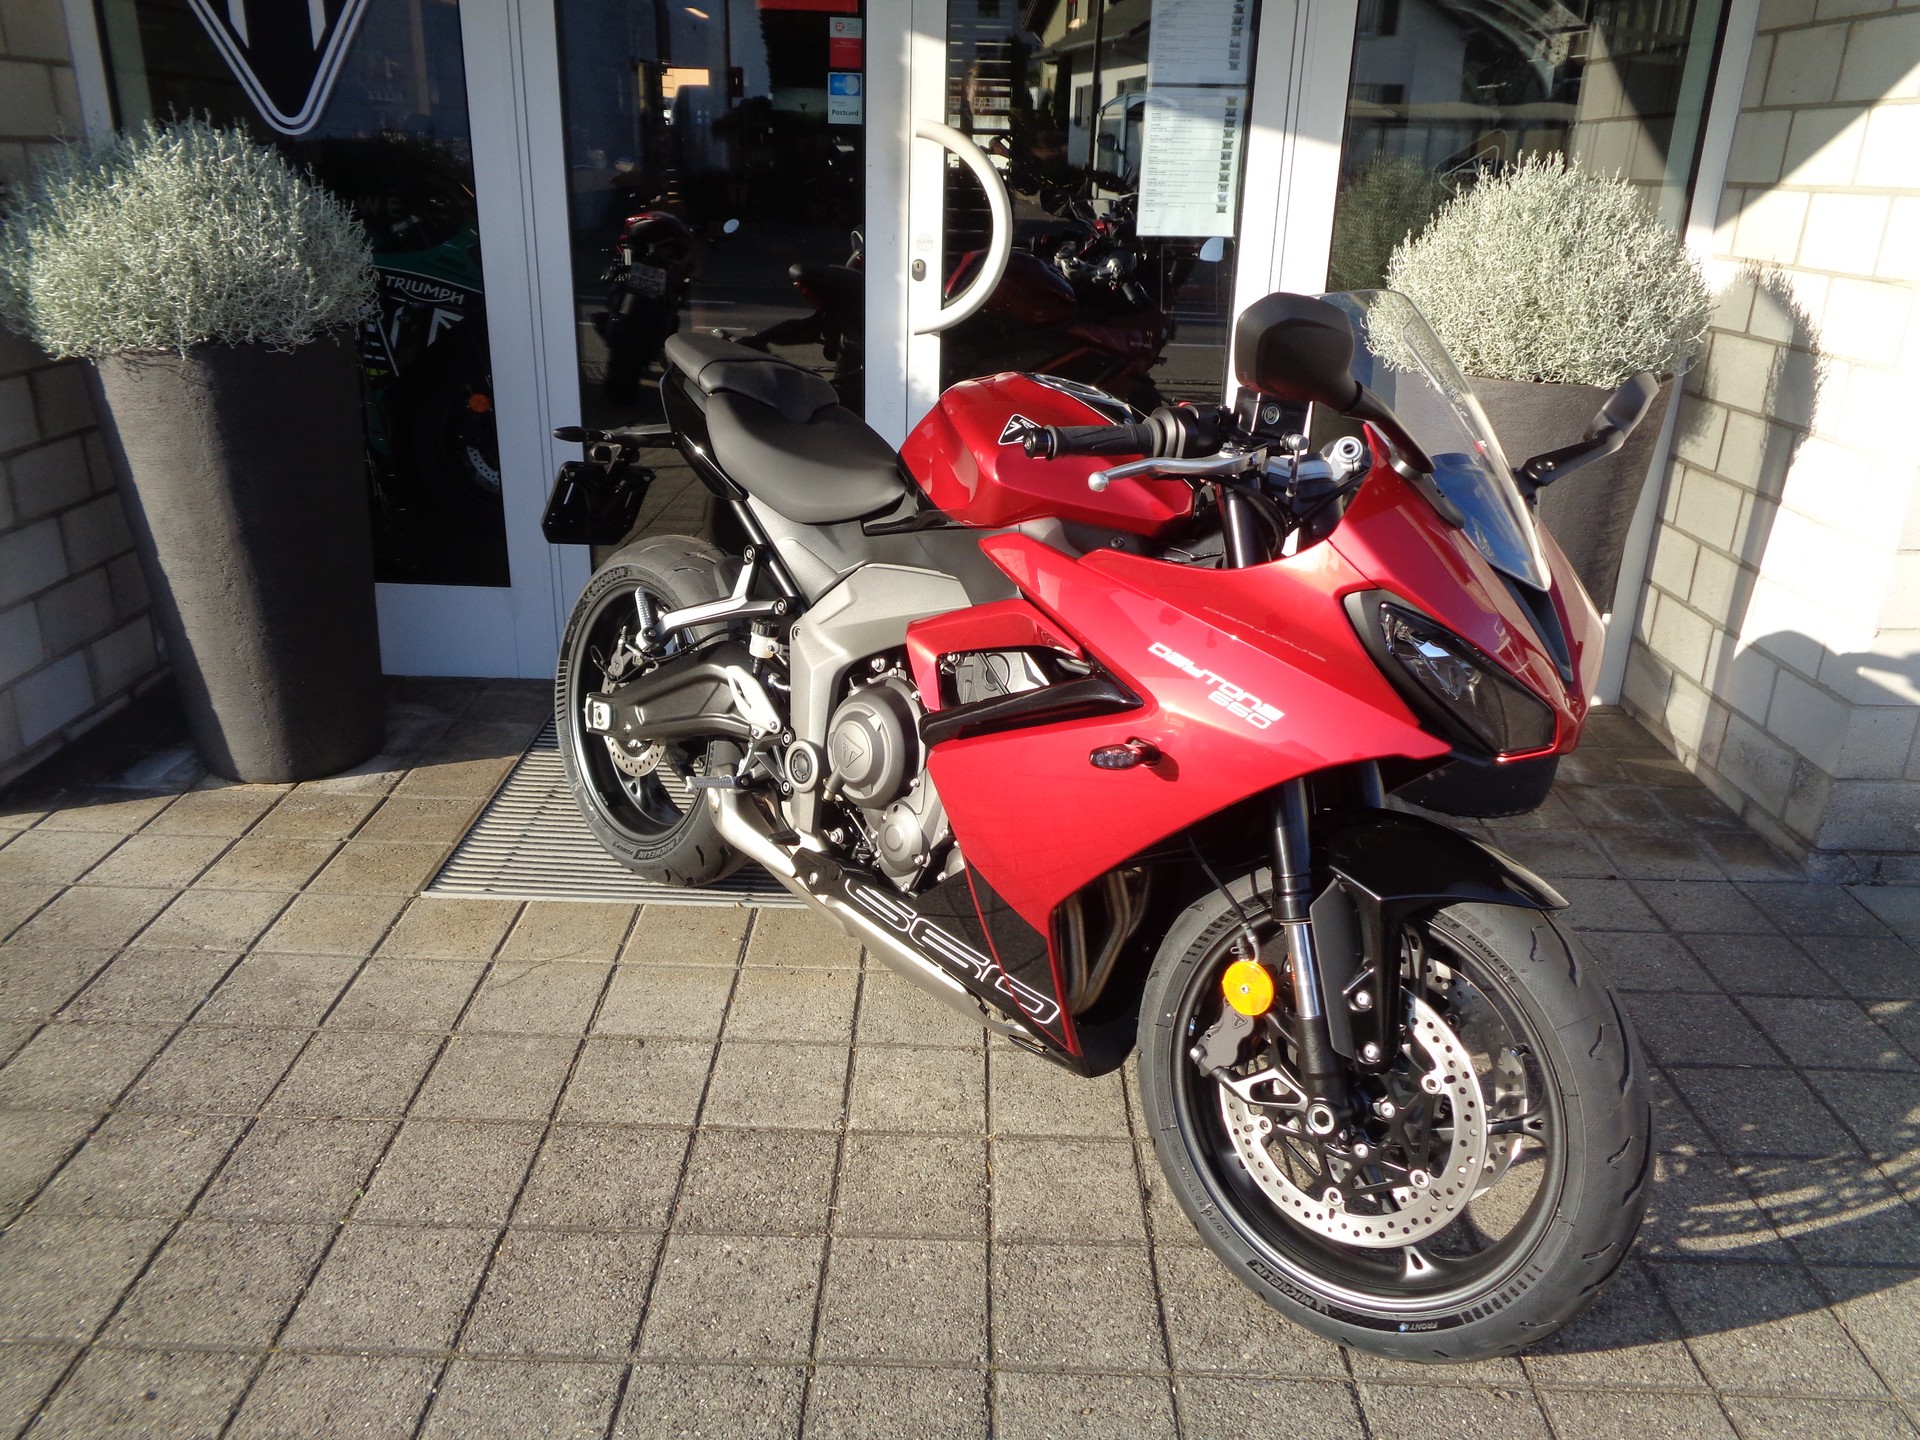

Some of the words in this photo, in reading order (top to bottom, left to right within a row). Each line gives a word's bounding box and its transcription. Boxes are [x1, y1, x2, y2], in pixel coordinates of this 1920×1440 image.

[831, 109, 859, 117] Postcard
[385, 275, 465, 305] TRIUMPH
[591, 567, 625, 594] MICHELIN
[1208, 690, 1272, 729] 660
[638, 841, 674, 859] MICHELIN
[844, 878, 1061, 1024] 660
[1466, 934, 1508, 972] POWER
[1204, 1209, 1231, 1239] 120/70
[1252, 1262, 1316, 1306] MICHELIN
[1410, 1321, 1438, 1331] FRONT
